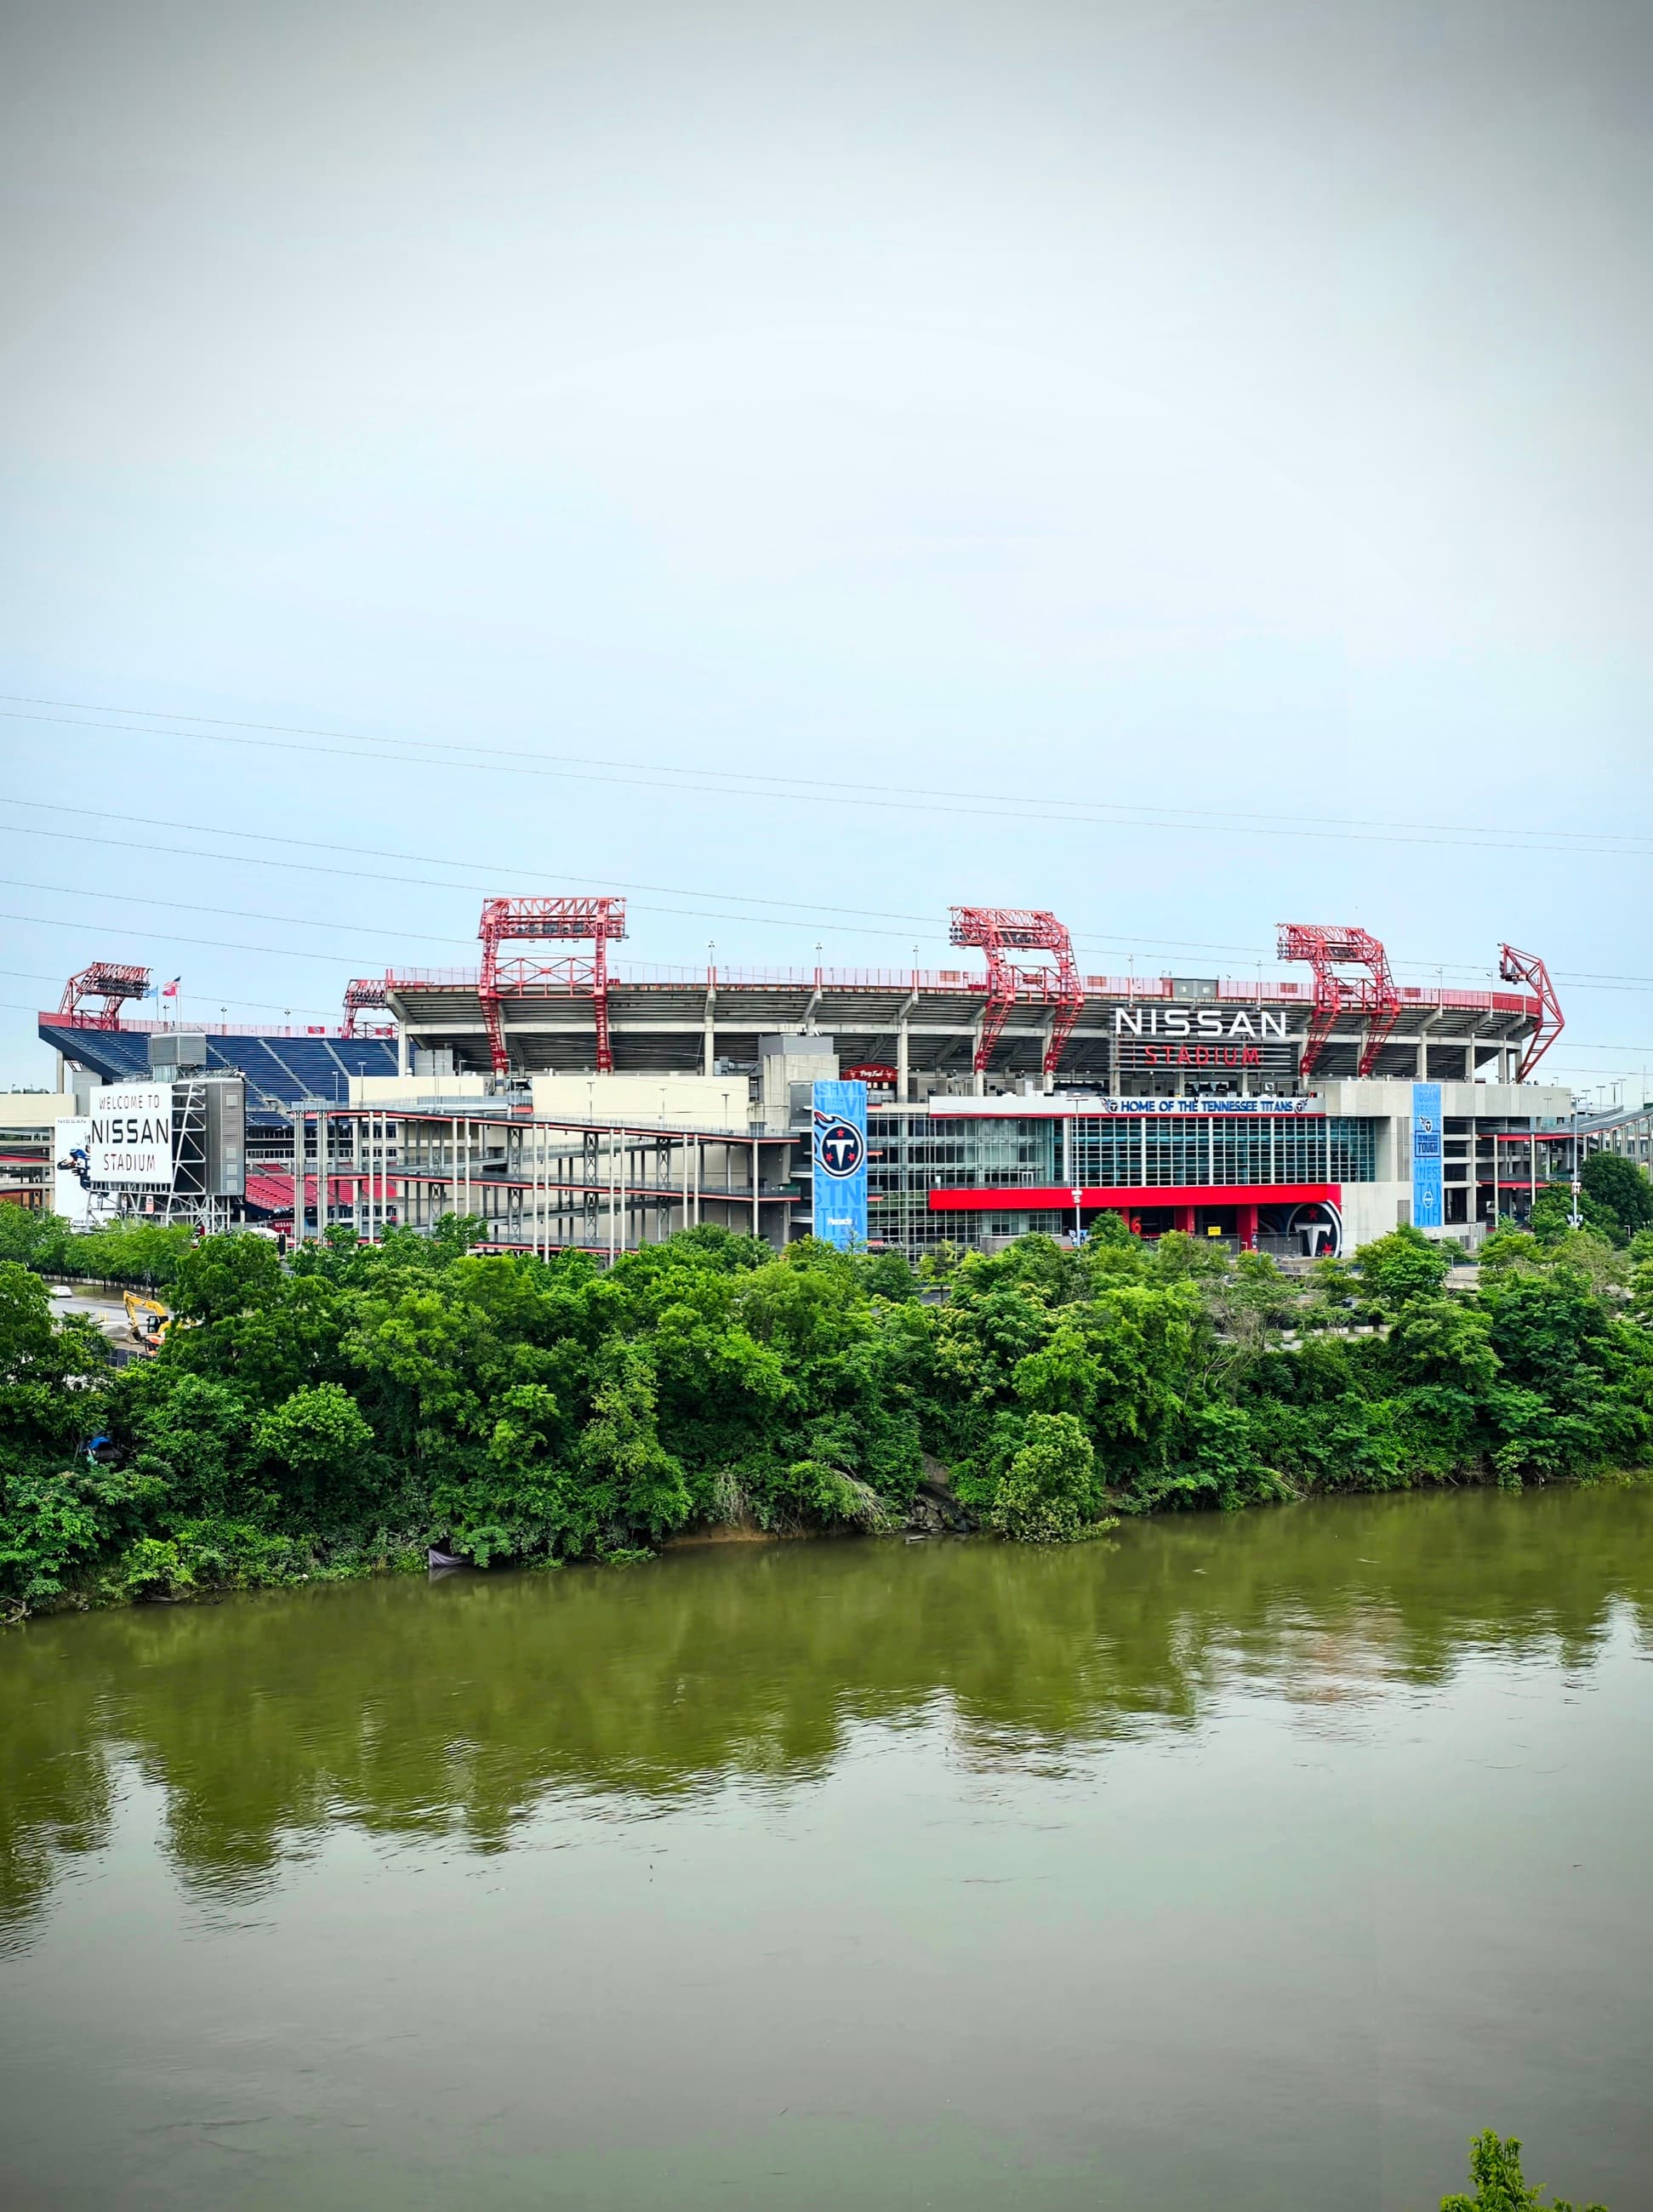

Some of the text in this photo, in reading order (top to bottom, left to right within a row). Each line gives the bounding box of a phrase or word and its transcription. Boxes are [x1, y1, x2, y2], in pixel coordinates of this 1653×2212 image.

[1115, 1007, 1287, 1038] NISSAN
[1144, 1045, 1260, 1065] STADIUM
[99, 1095, 160, 1109] WELCOME TO
[1121, 1101, 1292, 1112] HOME OF THE TENNESSEE TITANS
[92, 1118, 169, 1144] NISSAN
[1417, 1143, 1438, 1154] TOUGH
[103, 1154, 156, 1172] STADIUM
[1131, 1217, 1142, 1234] 6
